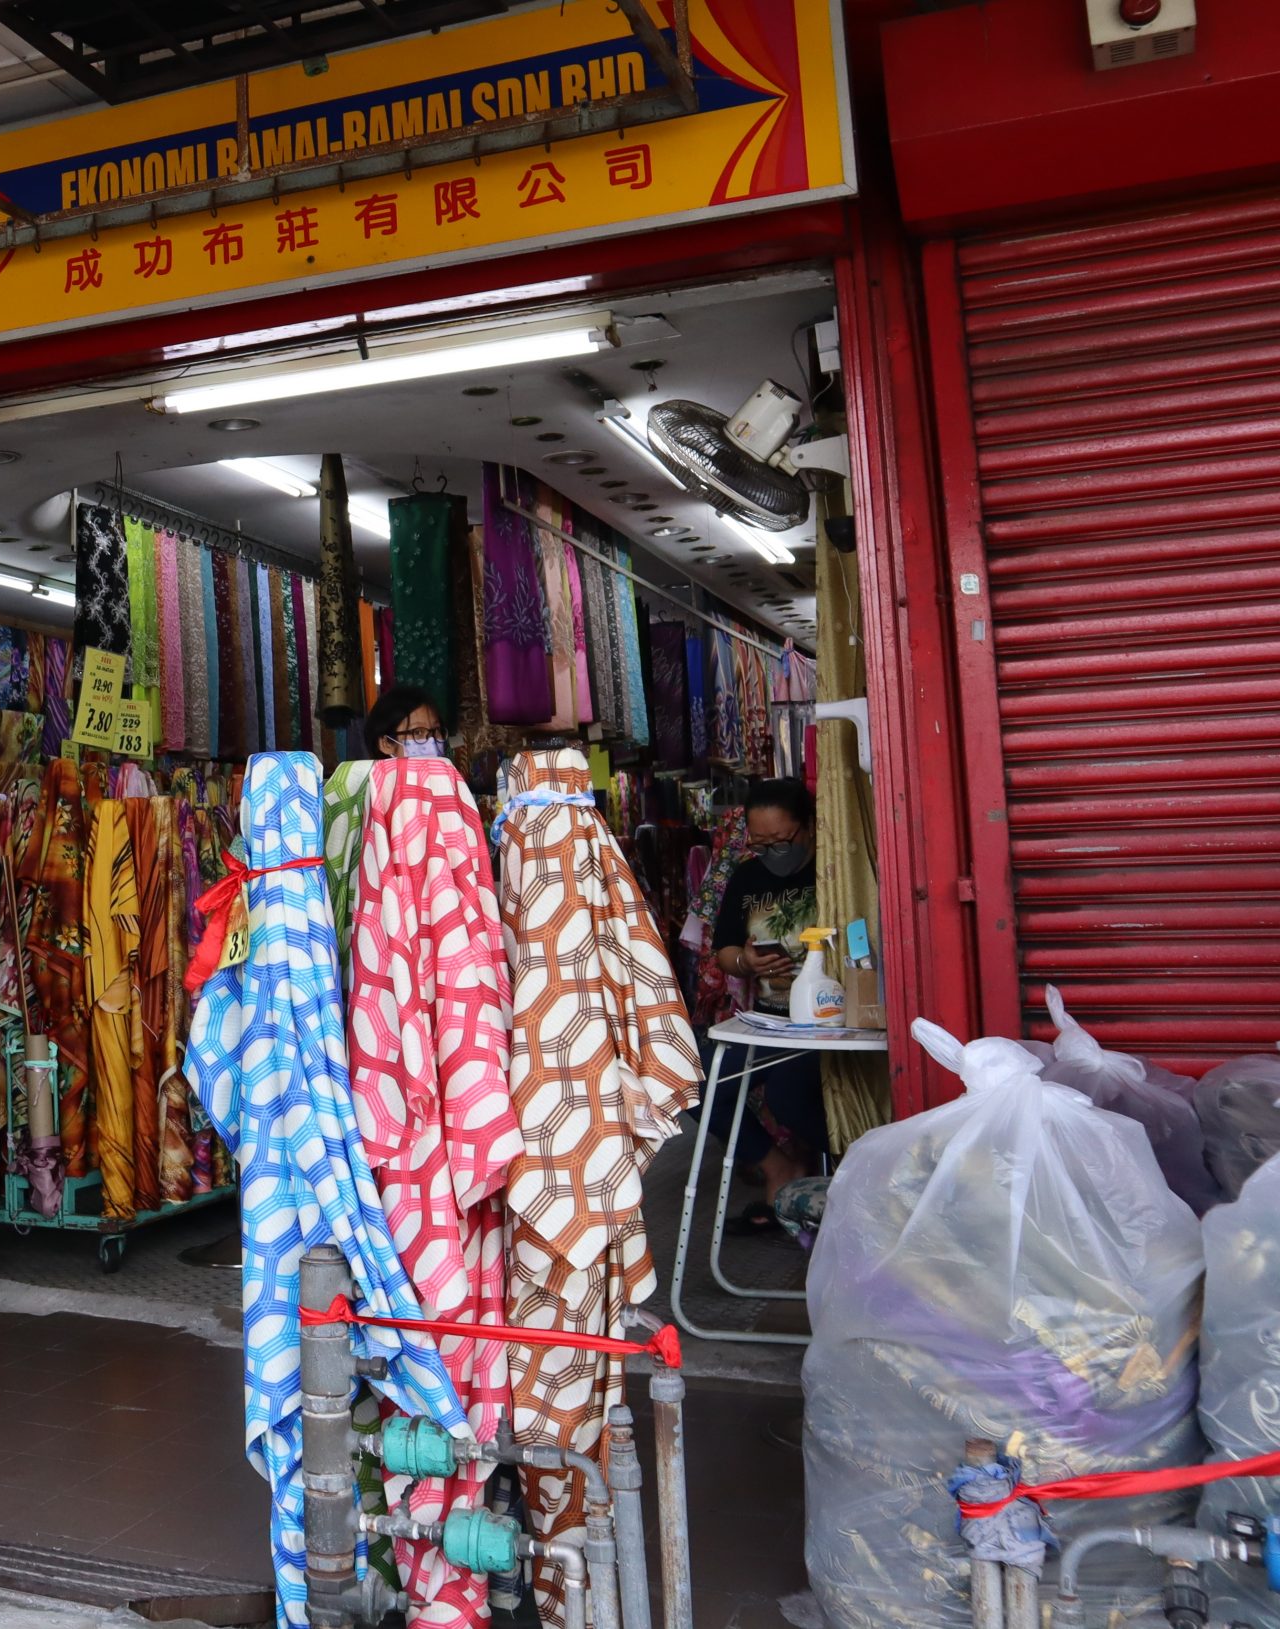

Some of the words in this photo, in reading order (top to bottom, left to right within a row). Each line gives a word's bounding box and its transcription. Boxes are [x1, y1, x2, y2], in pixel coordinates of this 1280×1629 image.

[64, 143, 652, 294] 成功布莊有限公司
[92, 678, 113, 694] 12.90
[85, 708, 113, 733] 7.80
[122, 718, 141, 729] 229
[119, 735, 142, 752] 183
